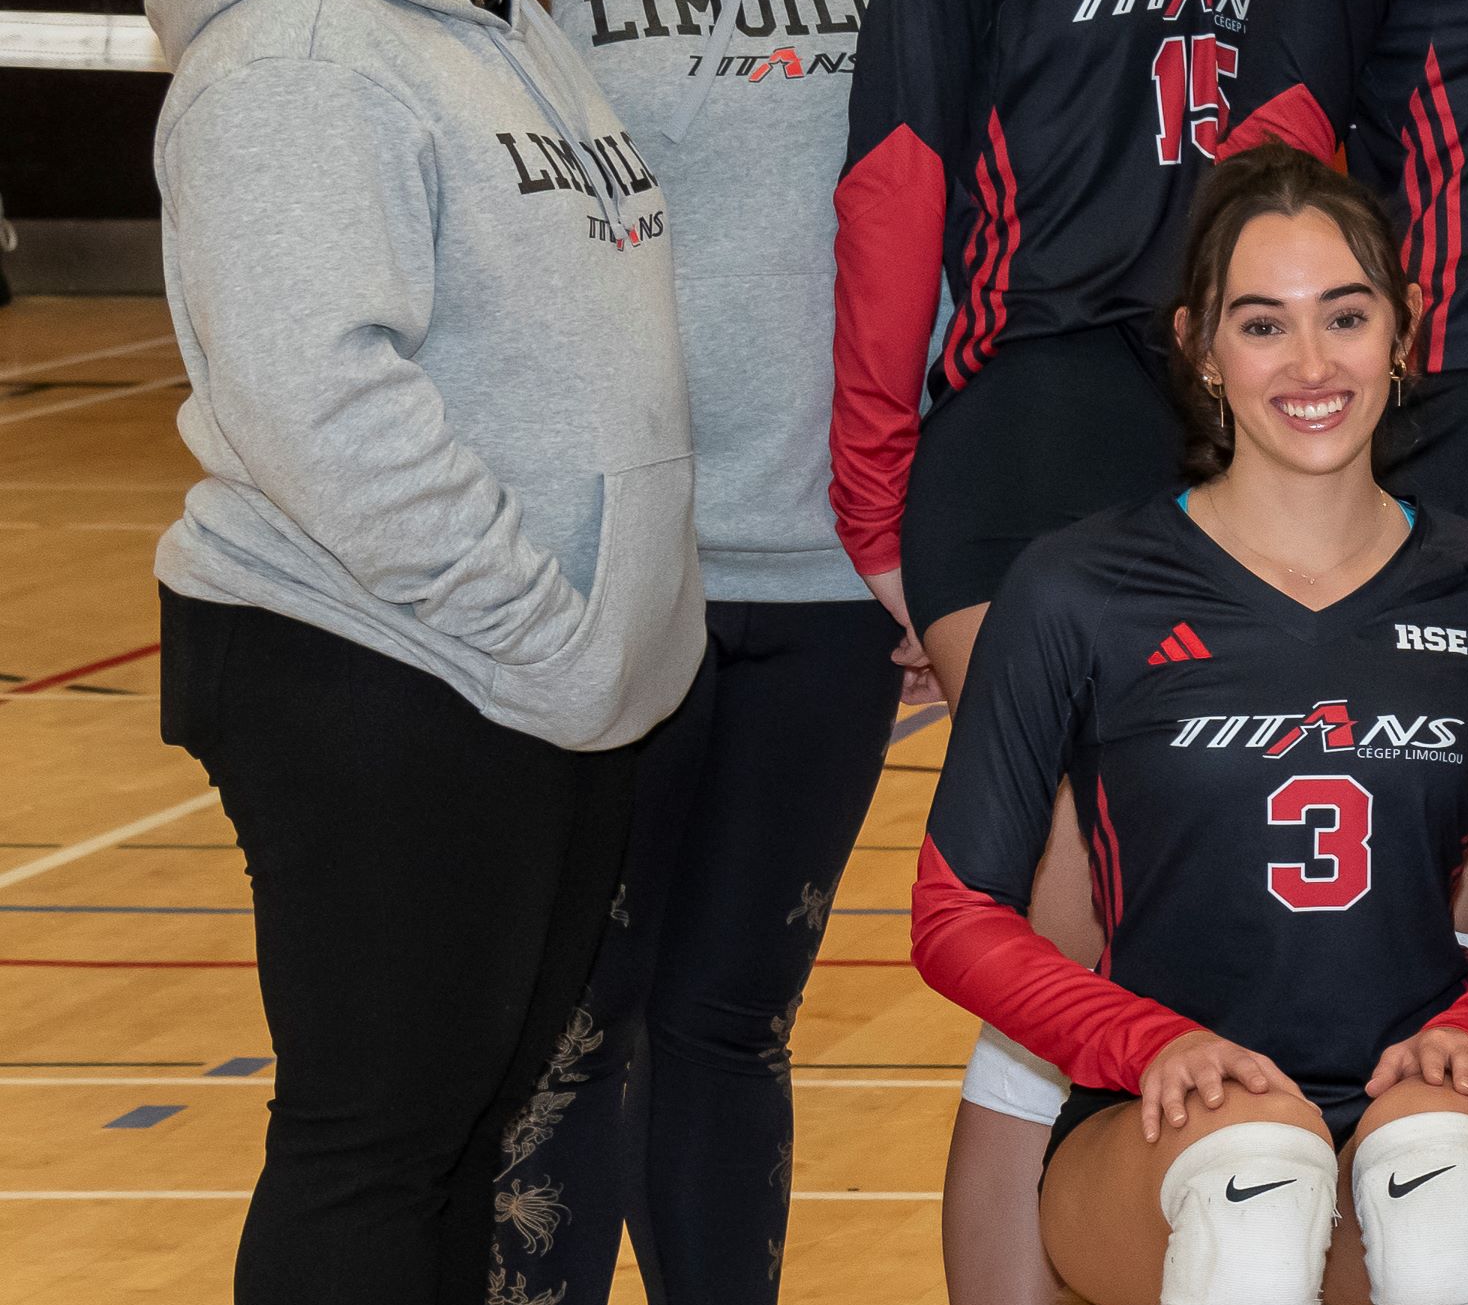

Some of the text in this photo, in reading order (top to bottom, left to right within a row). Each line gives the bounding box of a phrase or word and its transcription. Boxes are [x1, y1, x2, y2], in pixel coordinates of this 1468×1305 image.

[1213, 13, 1243, 33] CÉGEP
[1151, 33, 1239, 166] 15
[496, 130, 660, 197] LIMIL
[1169, 698, 1466, 760] TITANS
[1355, 742, 1465, 765] CÉGEP LIMOILOU
[1266, 773, 1373, 913] 3
